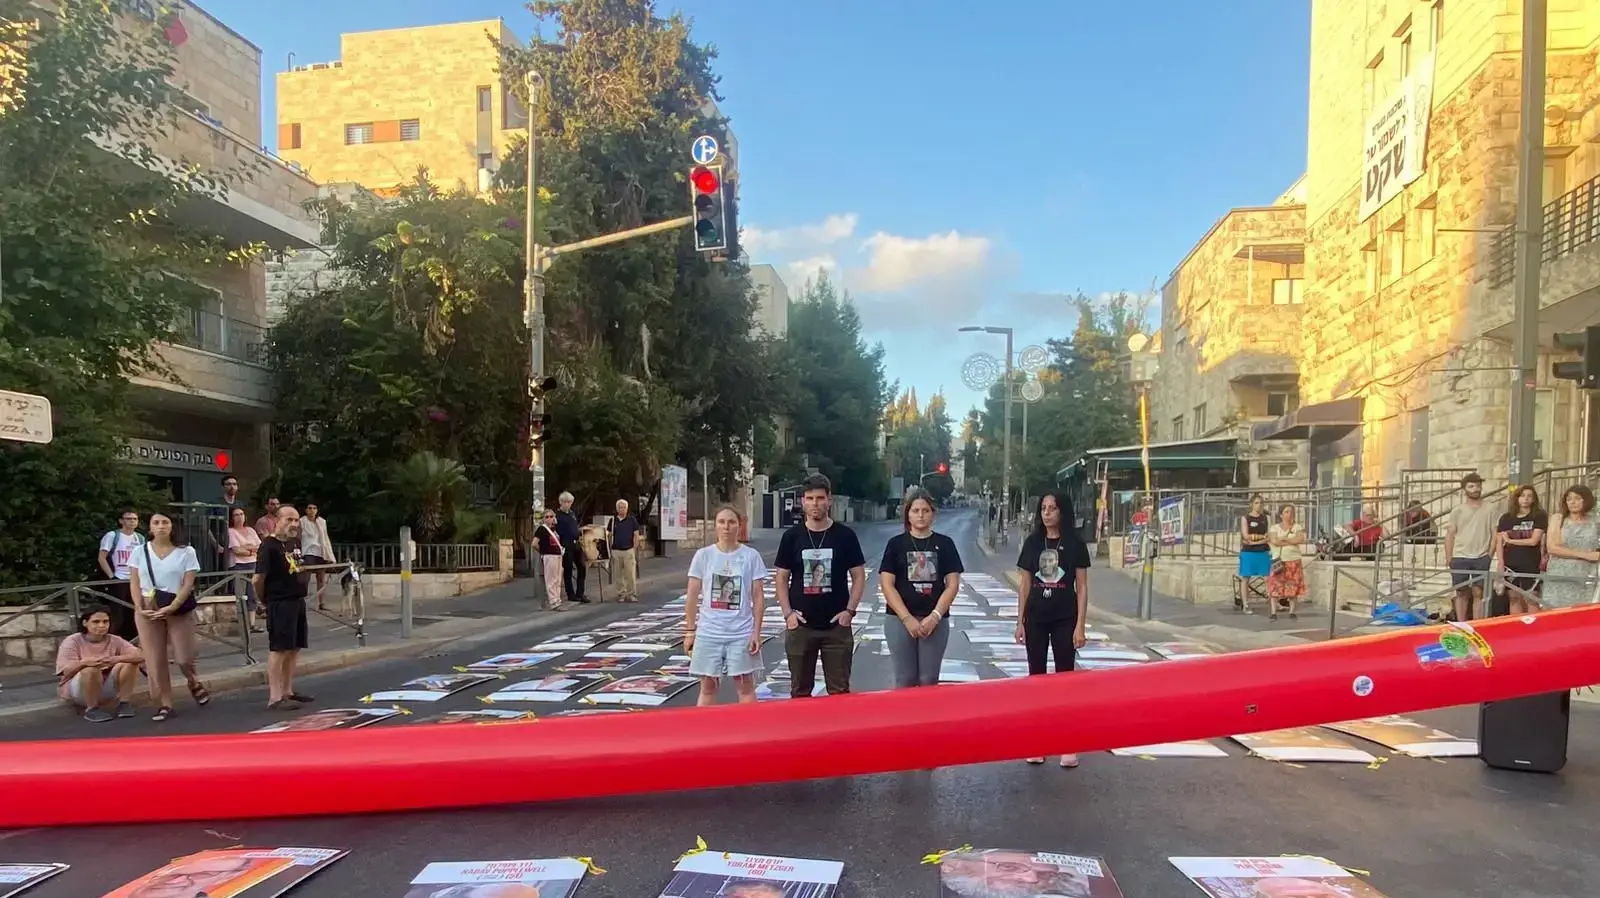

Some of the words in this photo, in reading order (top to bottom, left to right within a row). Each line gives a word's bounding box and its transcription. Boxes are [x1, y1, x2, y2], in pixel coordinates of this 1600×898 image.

[1366, 135, 1406, 203] שקט
[138, 445, 191, 464] הפועלים
[192, 453, 213, 466] בנק
[727, 861, 756, 869] YORAM
